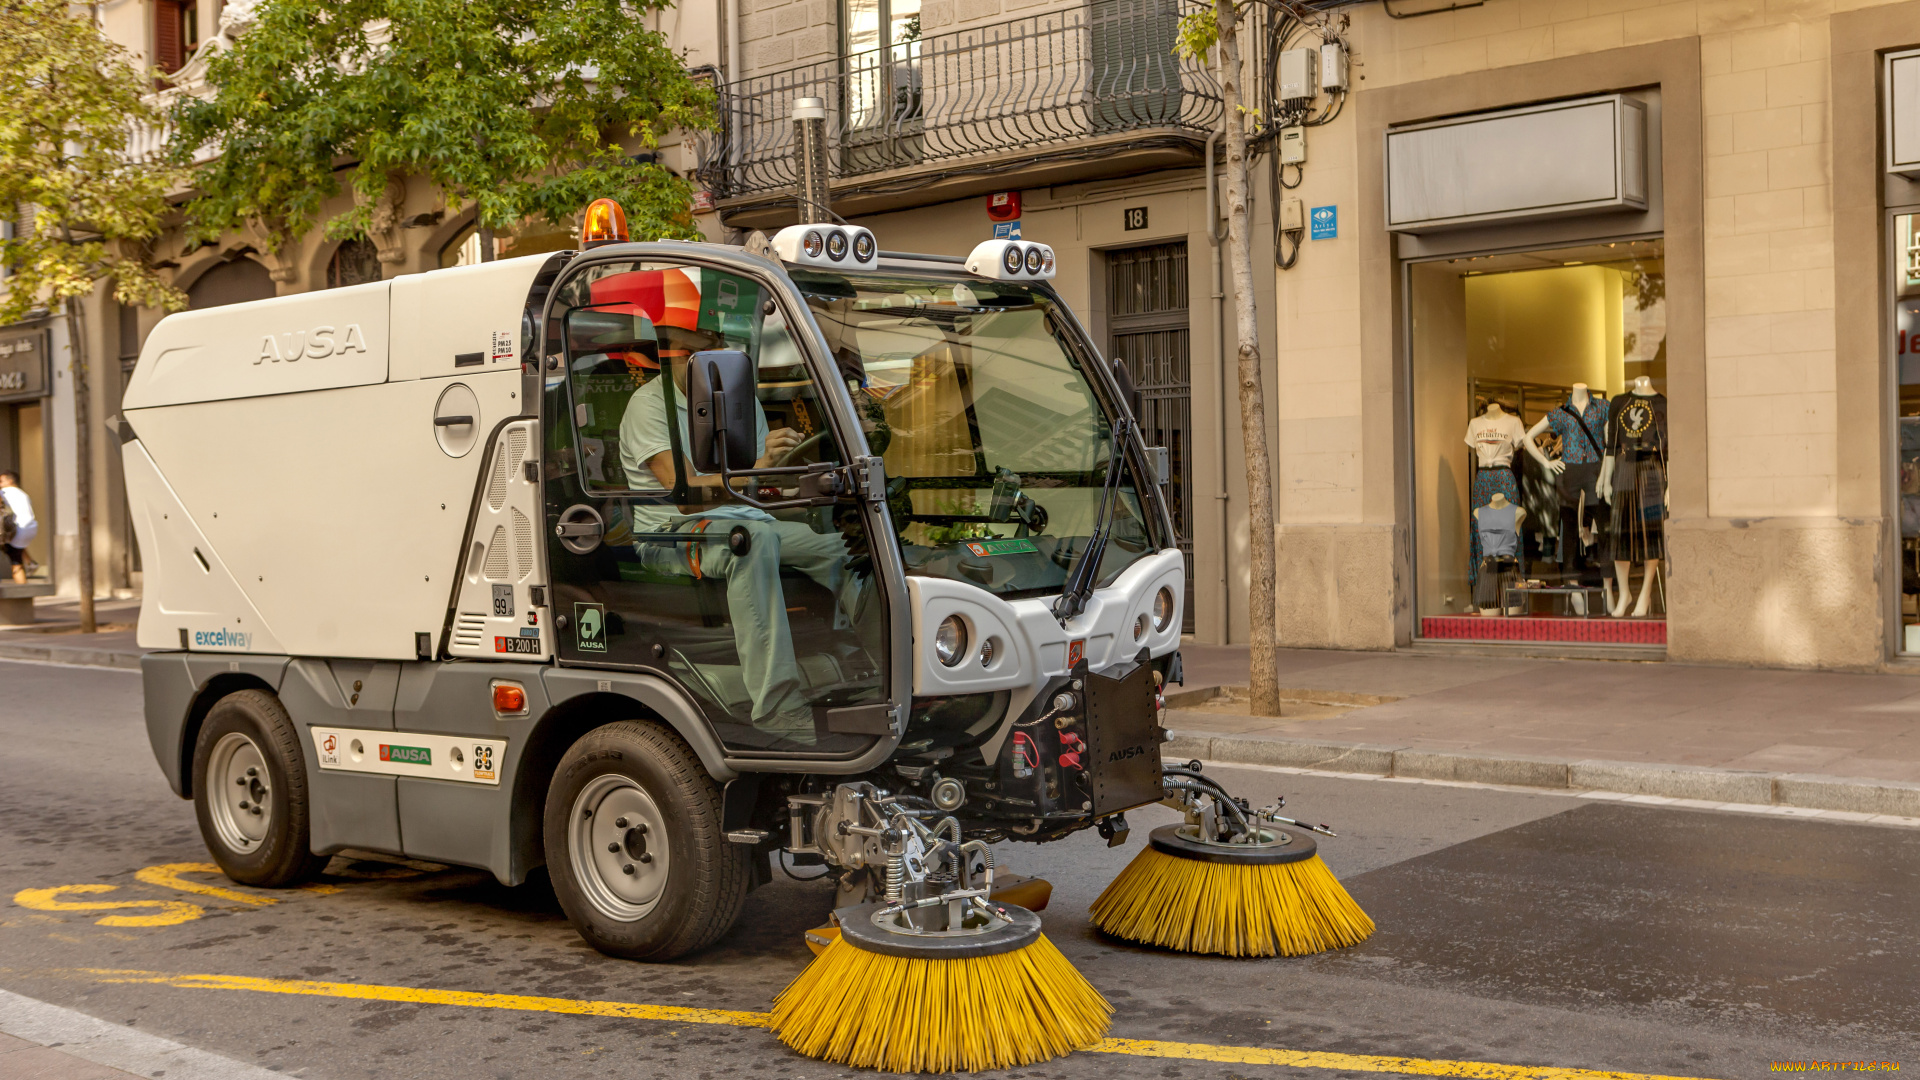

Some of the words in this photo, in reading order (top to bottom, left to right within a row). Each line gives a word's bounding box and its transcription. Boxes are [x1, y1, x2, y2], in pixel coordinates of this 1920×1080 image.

[1128, 209, 1143, 228] 18
[253, 323, 366, 365] AUSA
[987, 541, 1033, 553] AUSA
[494, 598, 507, 615] 99
[195, 627, 252, 650] excelway
[507, 637, 514, 651] B
[516, 637, 531, 652] 200
[532, 639, 539, 653] H
[580, 641, 604, 649] AUSA
[322, 754, 338, 764] iLink
[391, 748, 430, 762] AUSA
[1109, 745, 1144, 762] AUSA
